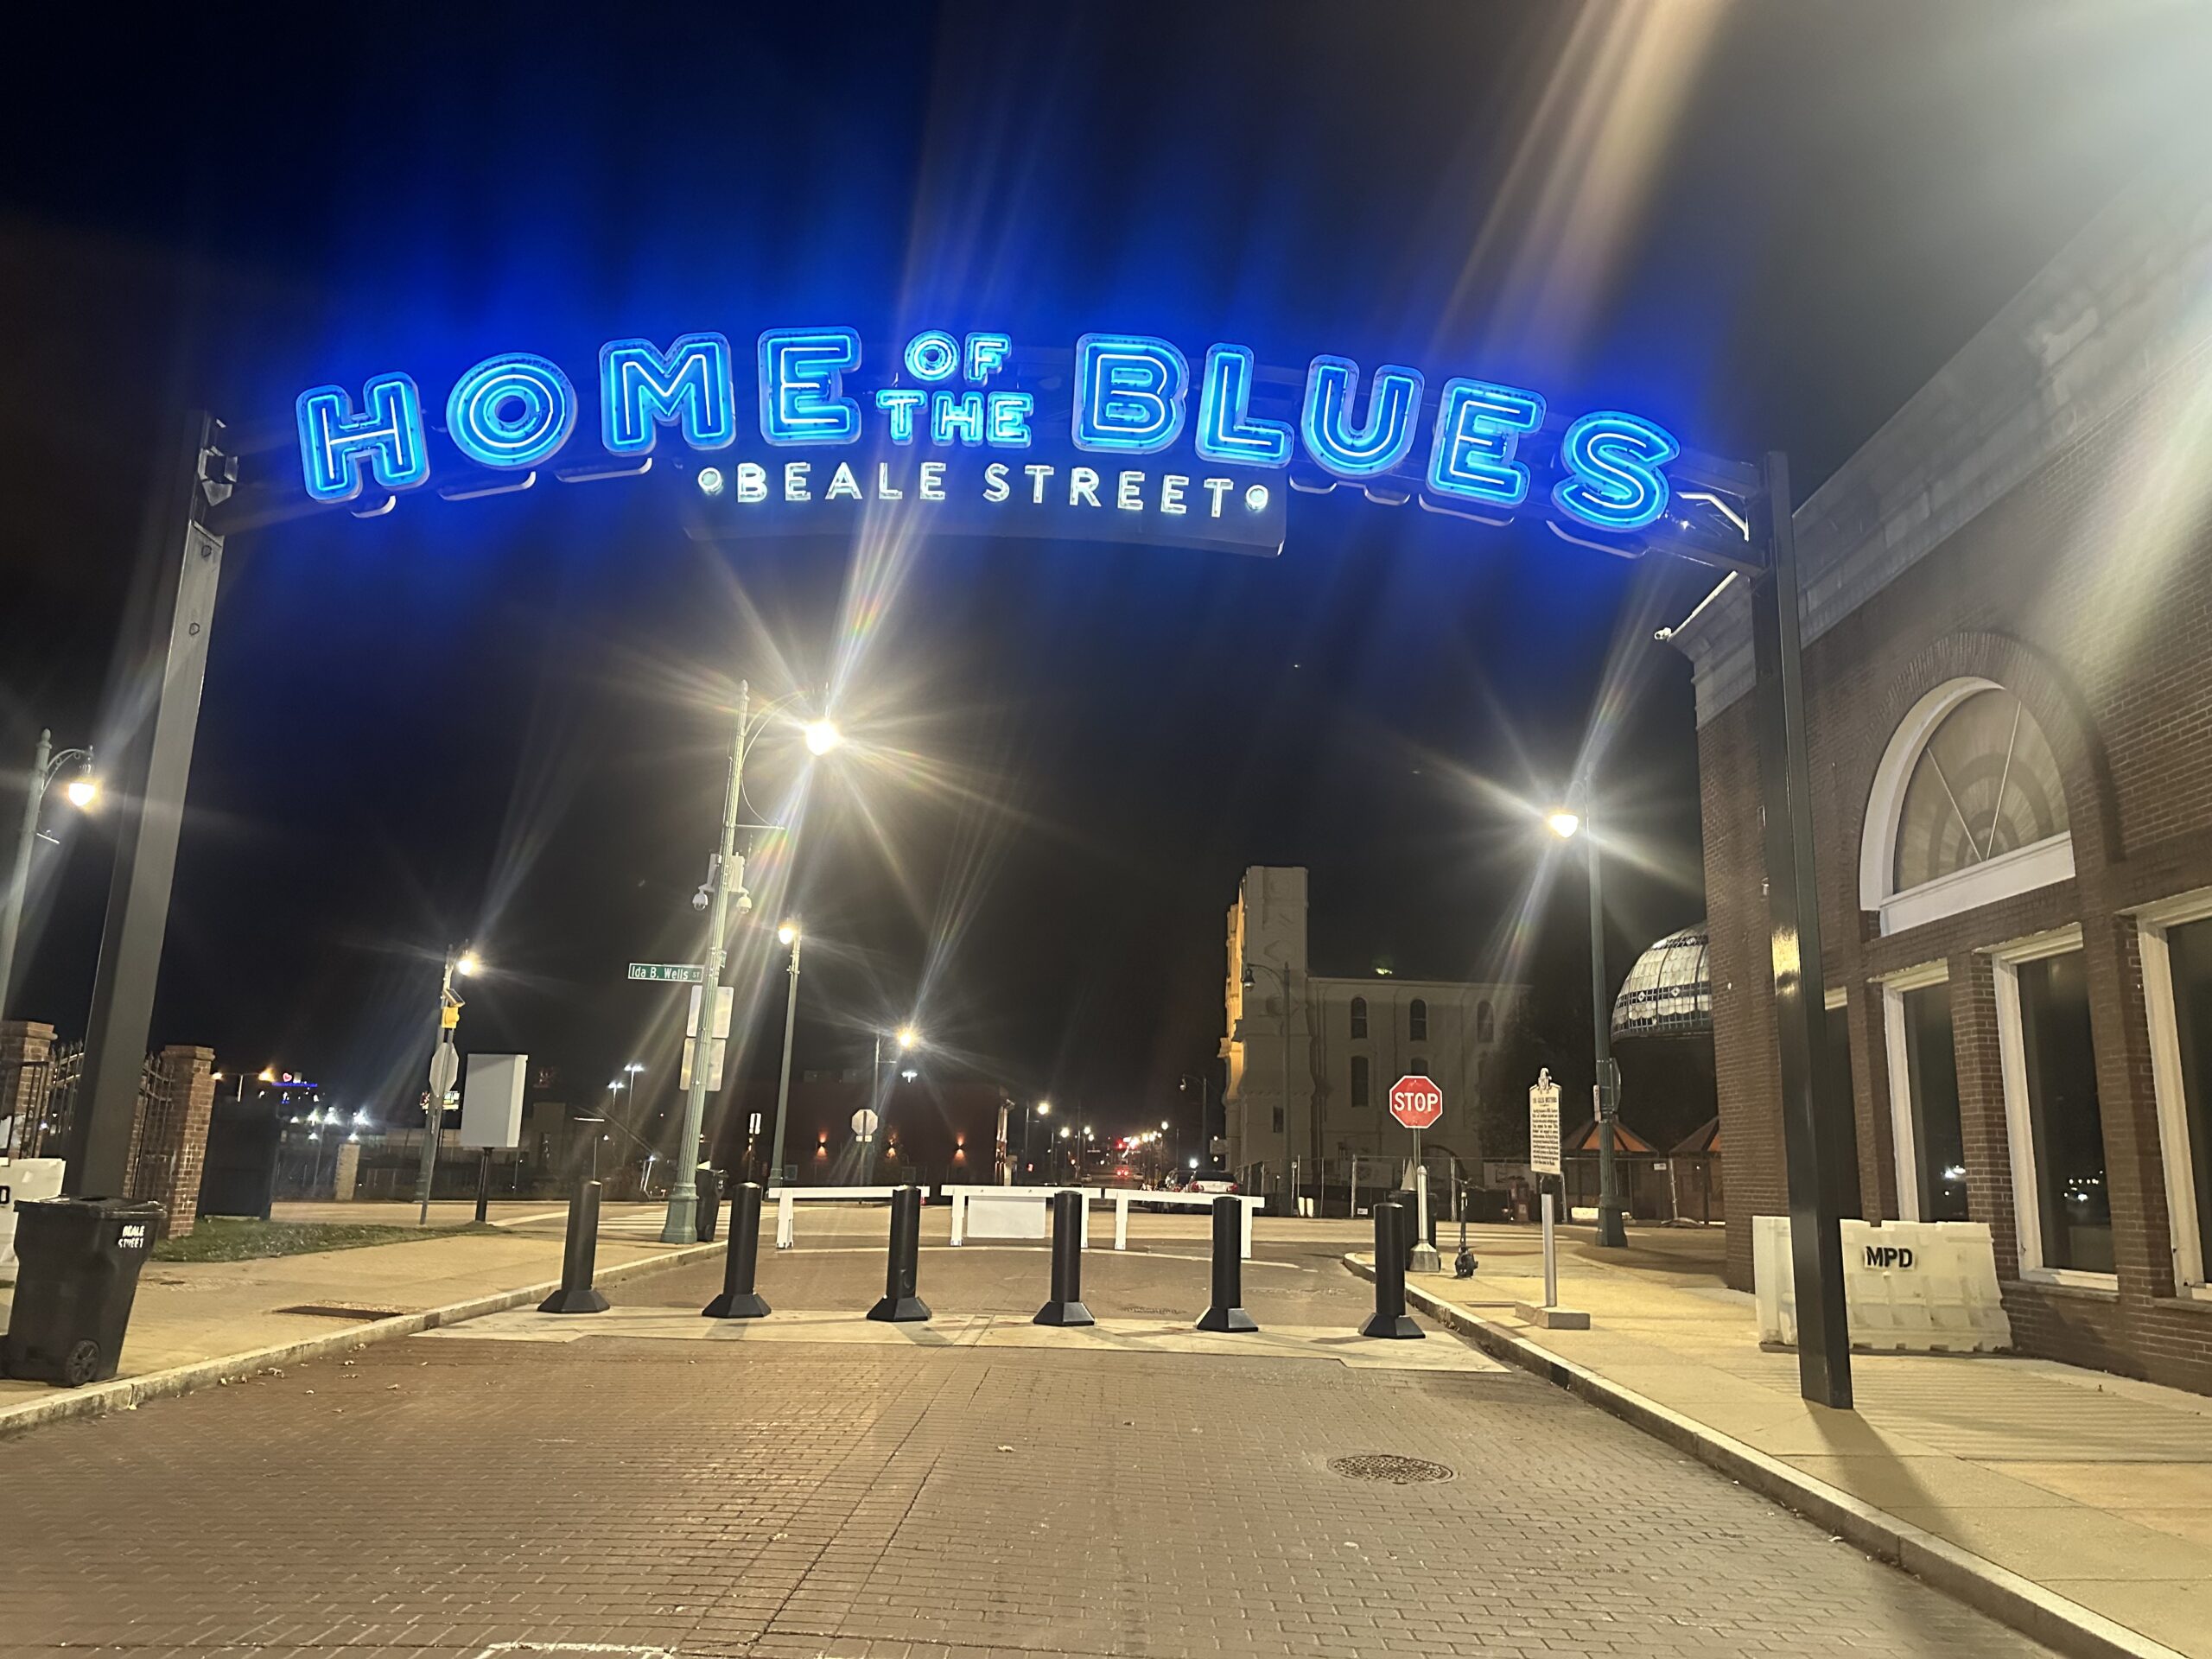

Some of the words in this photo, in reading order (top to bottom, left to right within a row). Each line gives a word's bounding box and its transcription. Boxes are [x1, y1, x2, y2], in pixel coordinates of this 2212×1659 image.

[903, 329, 1012, 385] OF
[296, 325, 861, 502] HOME
[875, 388, 1034, 447] THE
[1071, 332, 1681, 533] BLUES
[736, 461, 947, 504] BEALE
[983, 464, 1234, 518] STREET
[631, 965, 646, 978] Ida
[650, 967, 659, 979] B.
[664, 967, 689, 980] Wells
[1394, 1091, 1439, 1112] STOP
[1866, 1245, 1913, 1268] MPD
